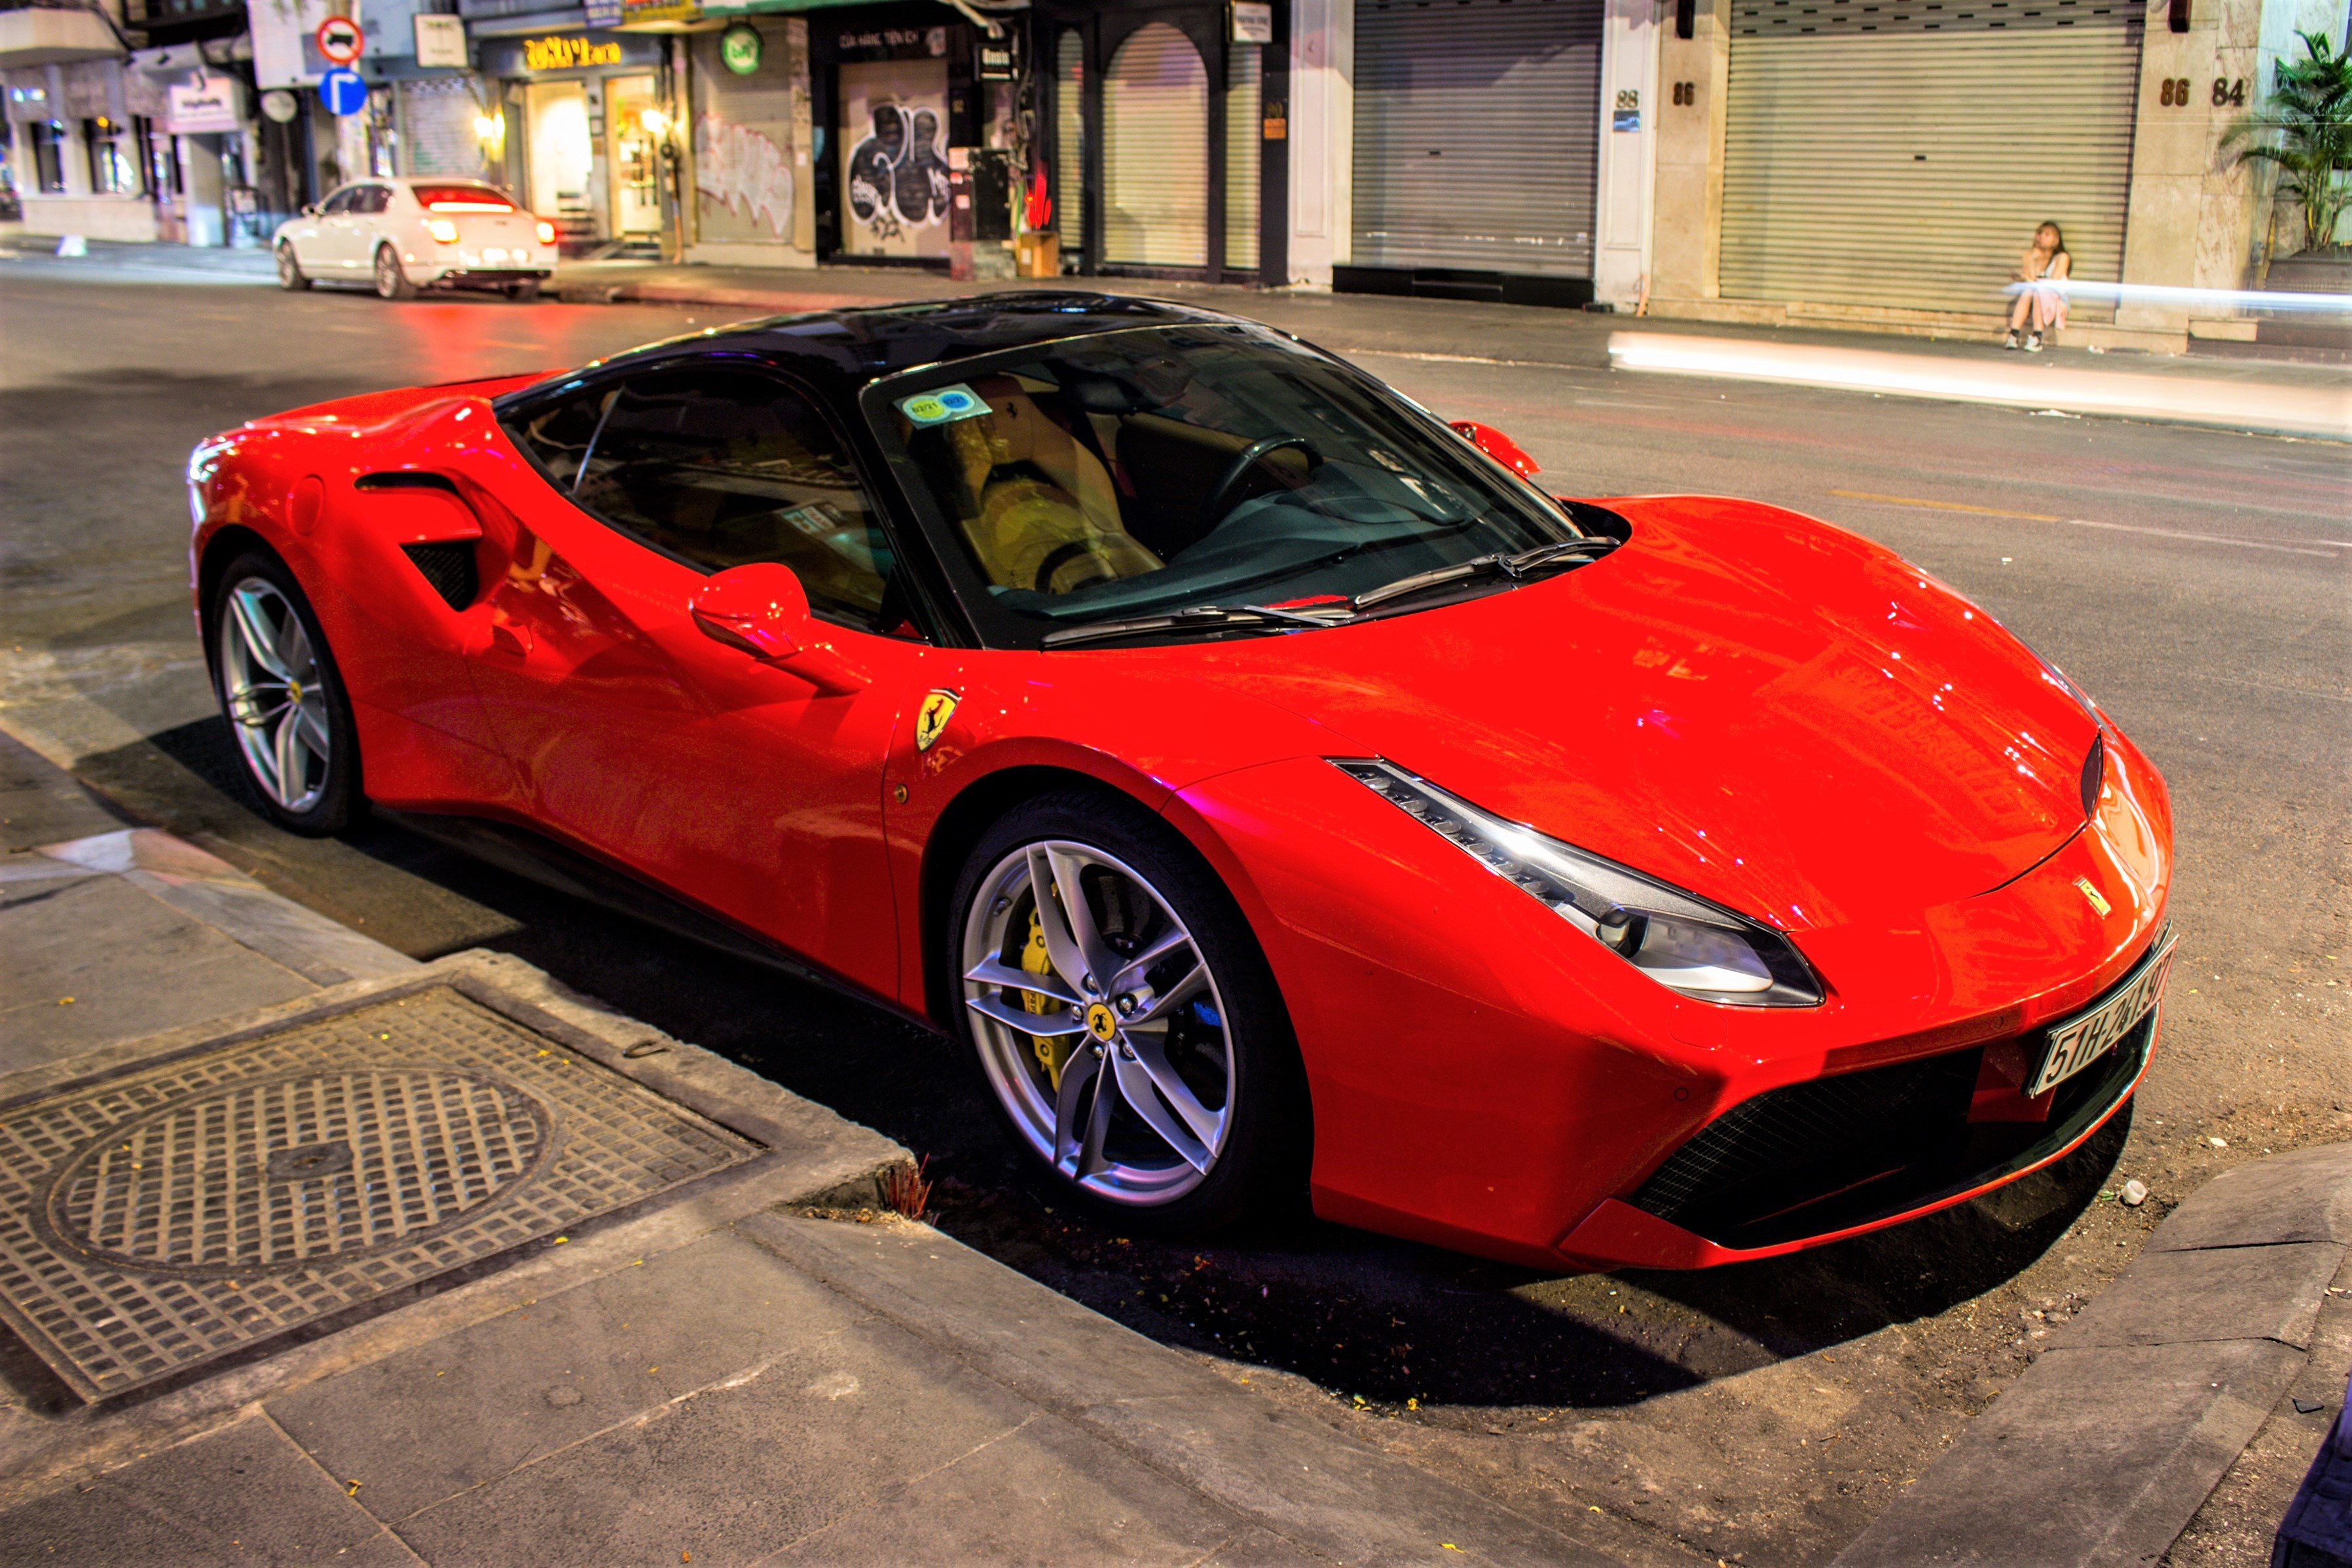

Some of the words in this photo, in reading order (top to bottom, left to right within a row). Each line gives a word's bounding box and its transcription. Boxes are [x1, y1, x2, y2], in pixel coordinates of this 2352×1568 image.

[982, 48, 1010, 65] Oasis
[1616, 90, 1639, 108] 88
[1673, 81, 1695, 107] 86
[2160, 78, 2190, 107] 86
[2212, 77, 2245, 107] 84
[2046, 949, 2174, 1084] 51H-241.97
